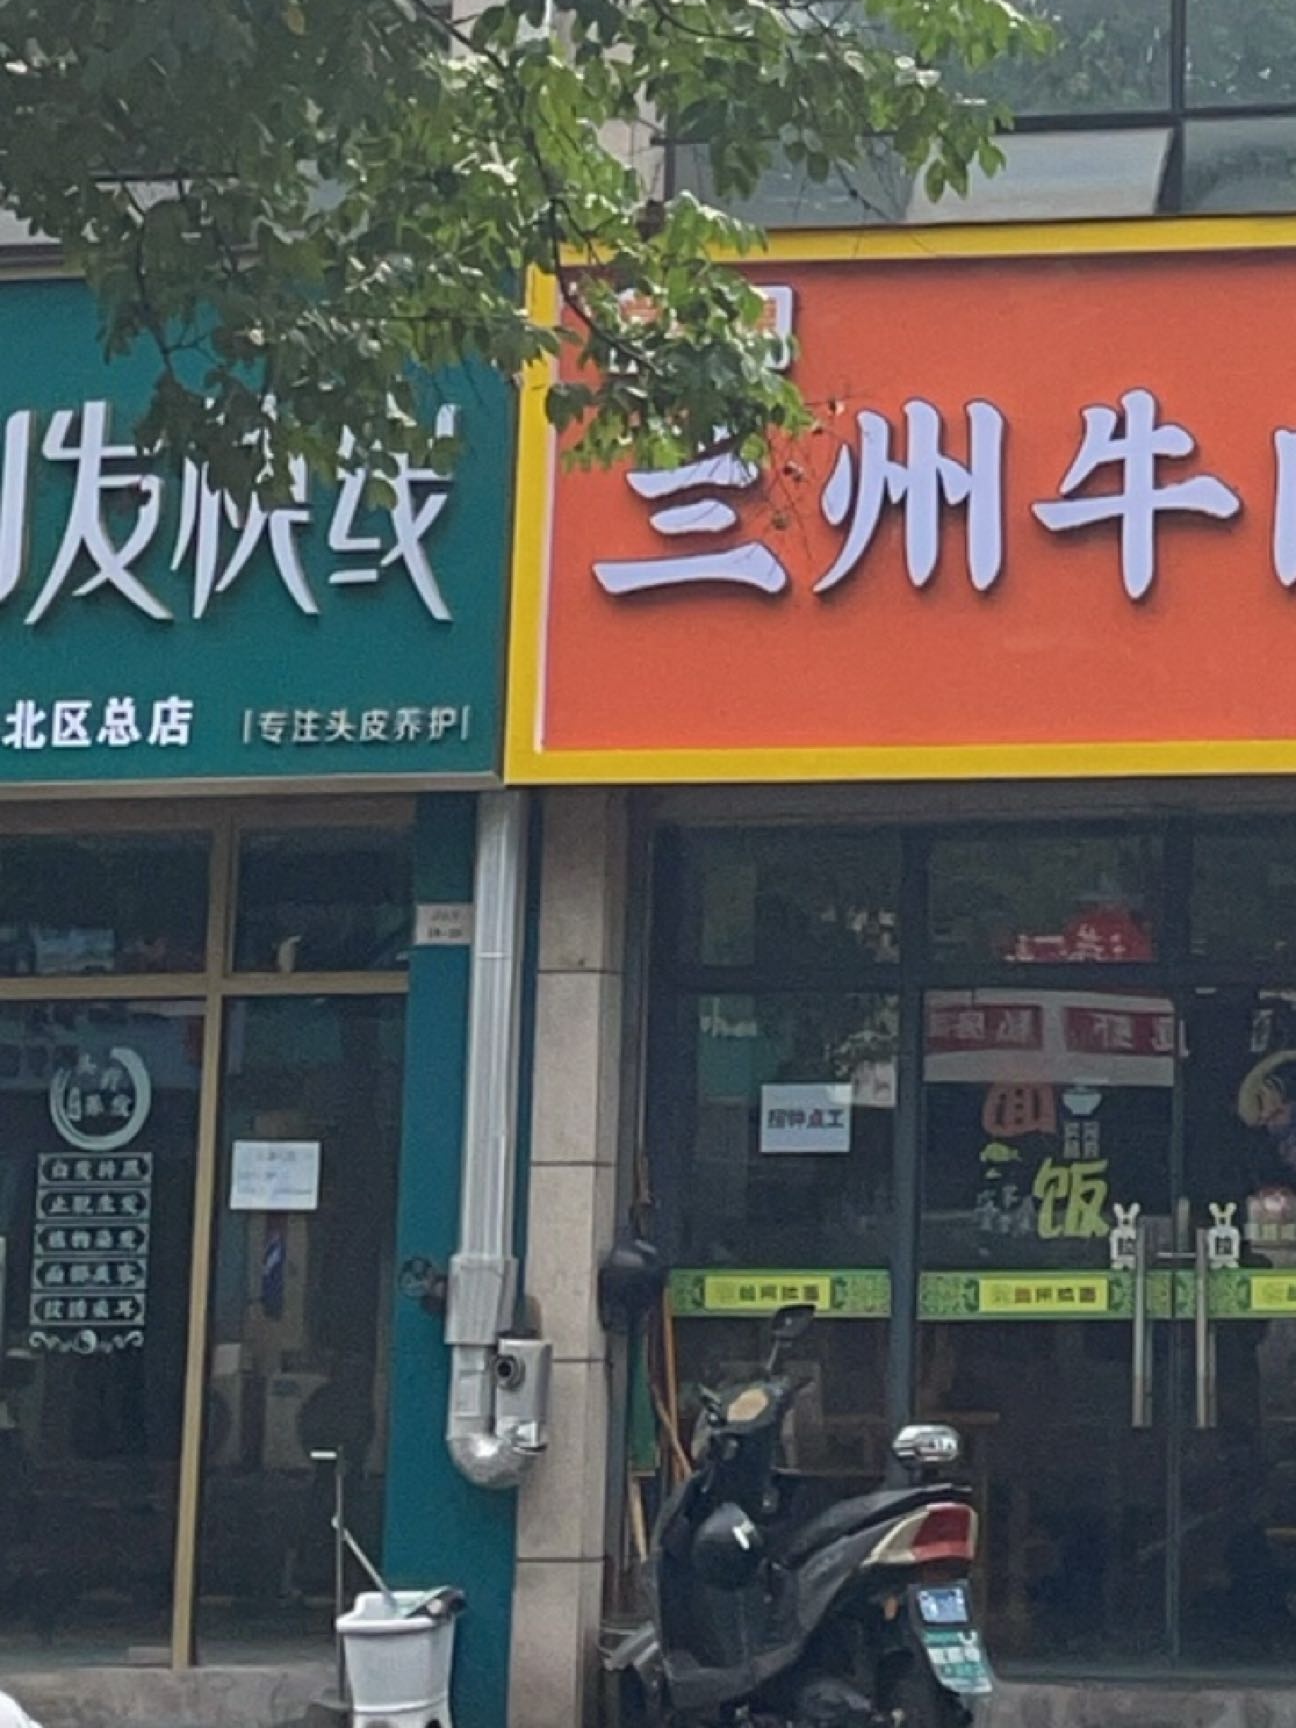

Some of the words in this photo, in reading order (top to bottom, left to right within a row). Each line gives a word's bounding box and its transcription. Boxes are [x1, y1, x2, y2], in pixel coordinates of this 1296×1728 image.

[0, 400, 456, 624] 发快线
[1, 695, 195, 750] 北区总店
[257, 707, 459, 743] 专注头皮养护
[1032, 1156, 1110, 1239] 饭
